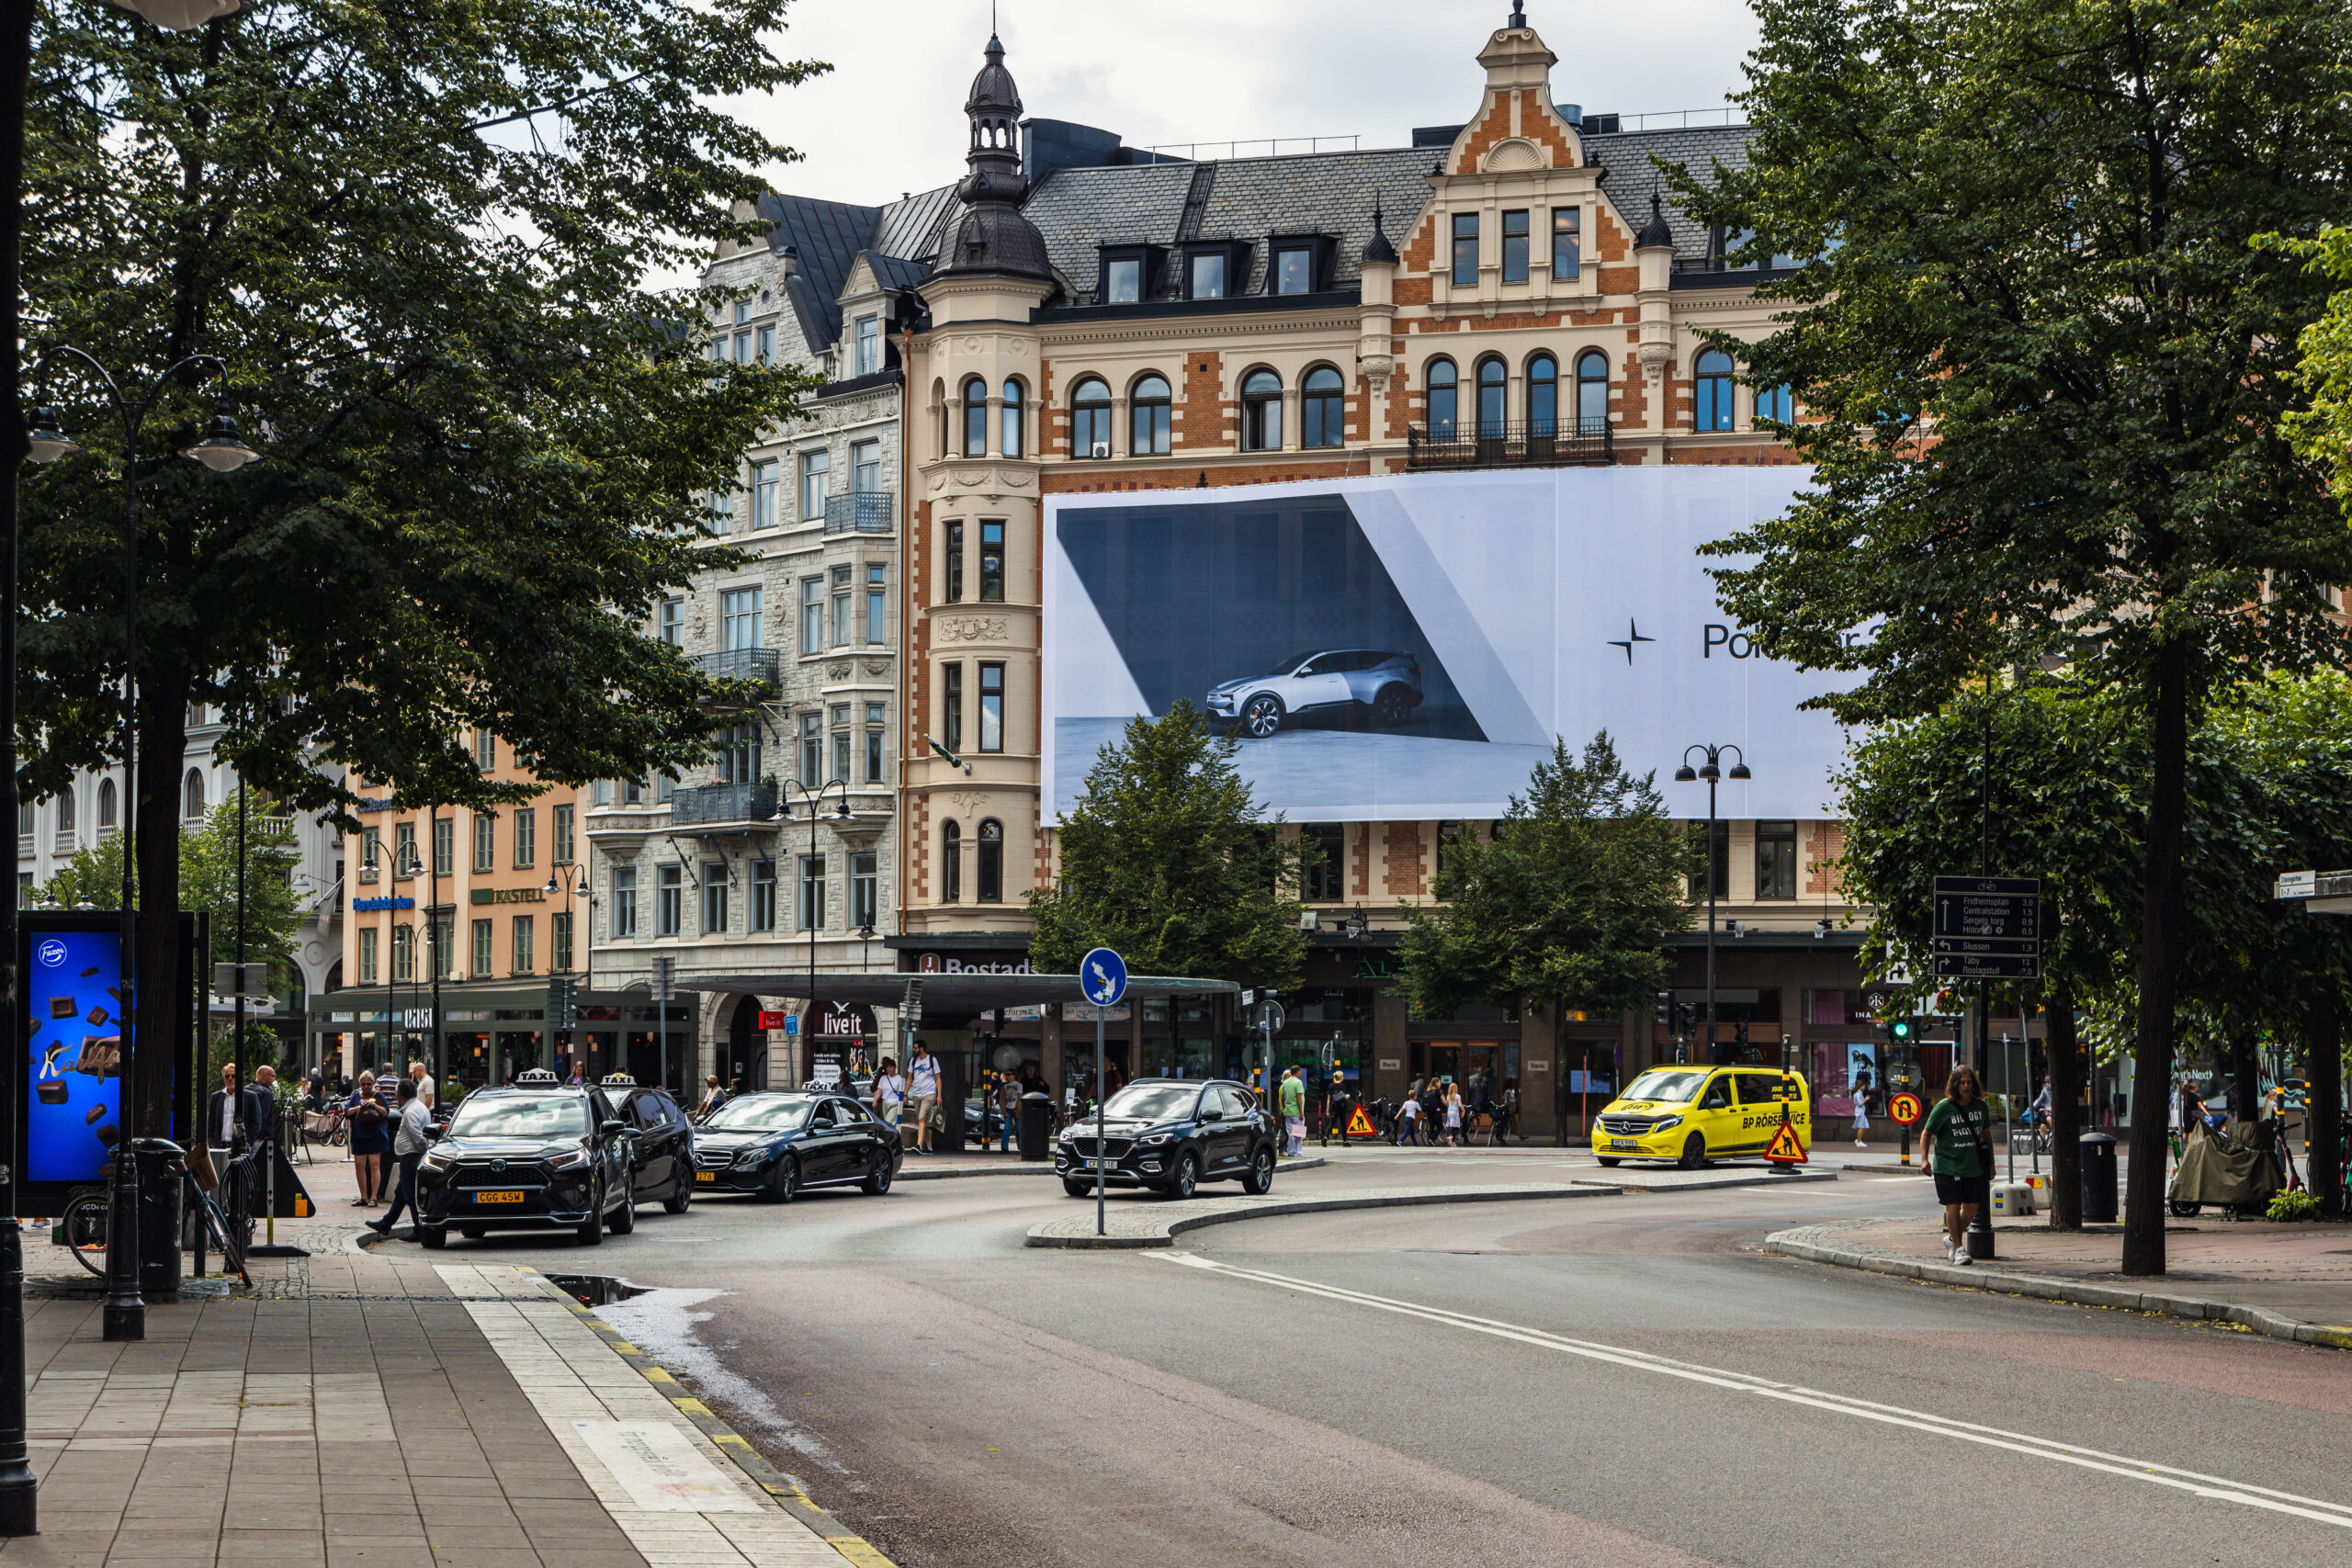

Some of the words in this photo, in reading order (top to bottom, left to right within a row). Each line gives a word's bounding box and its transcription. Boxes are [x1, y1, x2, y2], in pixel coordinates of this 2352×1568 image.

[1704, 624, 1860, 659] Polr
[496, 887, 547, 903] KASTELL
[353, 895, 414, 911] Handelsbanken
[1963, 897, 2009, 907] Fridhemsplan
[1963, 907, 2010, 916] Centralstation
[1963, 916, 1988, 926] Sergels
[1990, 917, 2005, 927] torg
[1962, 942, 1990, 951] Slussen
[1962, 966, 2000, 975] Roslagstull
[824, 1012, 849, 1034] live
[850, 1013, 862, 1034] it
[2192, 1069, 2210, 1080] Next
[1743, 1118, 1754, 1129] BP
[1756, 1113, 1805, 1128] RÖRSEVICE
[480, 1193, 498, 1202] CGG
[501, 1192, 520, 1201] 45W
